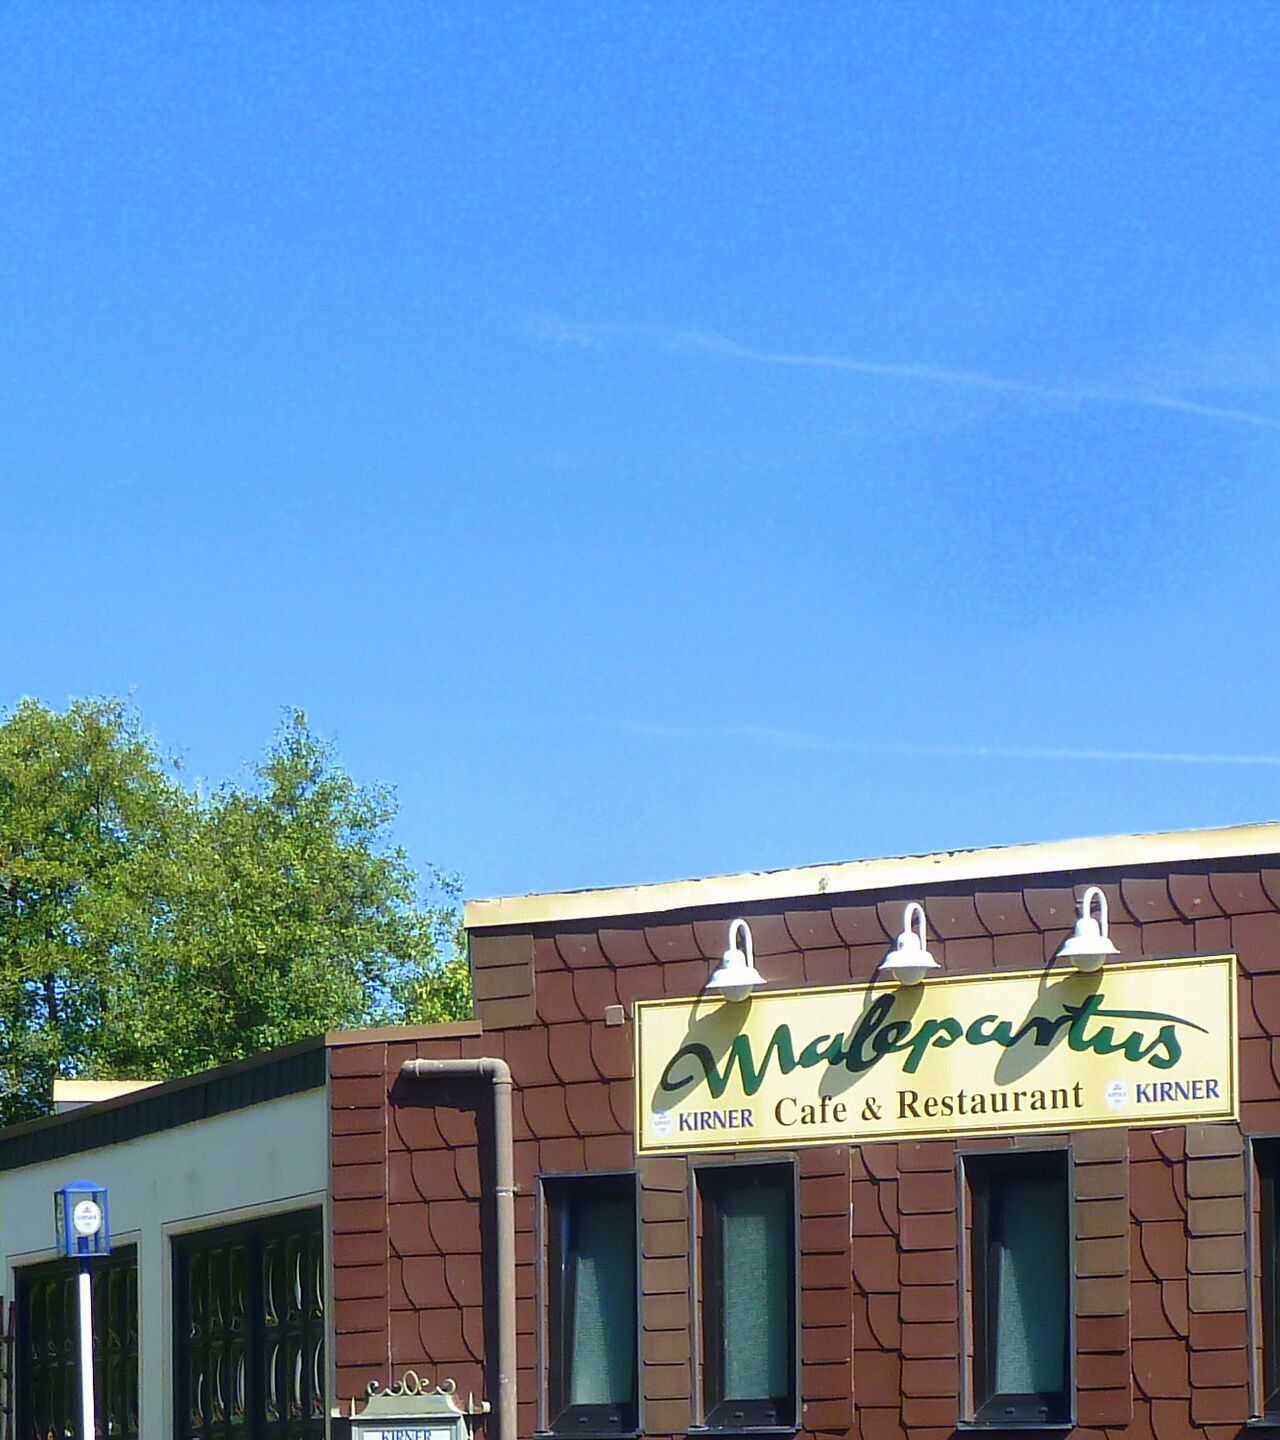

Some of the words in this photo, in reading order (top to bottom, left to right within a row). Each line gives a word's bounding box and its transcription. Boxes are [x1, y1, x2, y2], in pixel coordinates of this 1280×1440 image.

[661, 993, 1209, 1099] Malepartus
[775, 1095, 847, 1126] Cafe
[861, 1097, 882, 1121] &
[896, 1081, 1084, 1119] Restaurant
[1136, 1079, 1220, 1104] KIRNER
[679, 1108, 754, 1131] KIRNER
